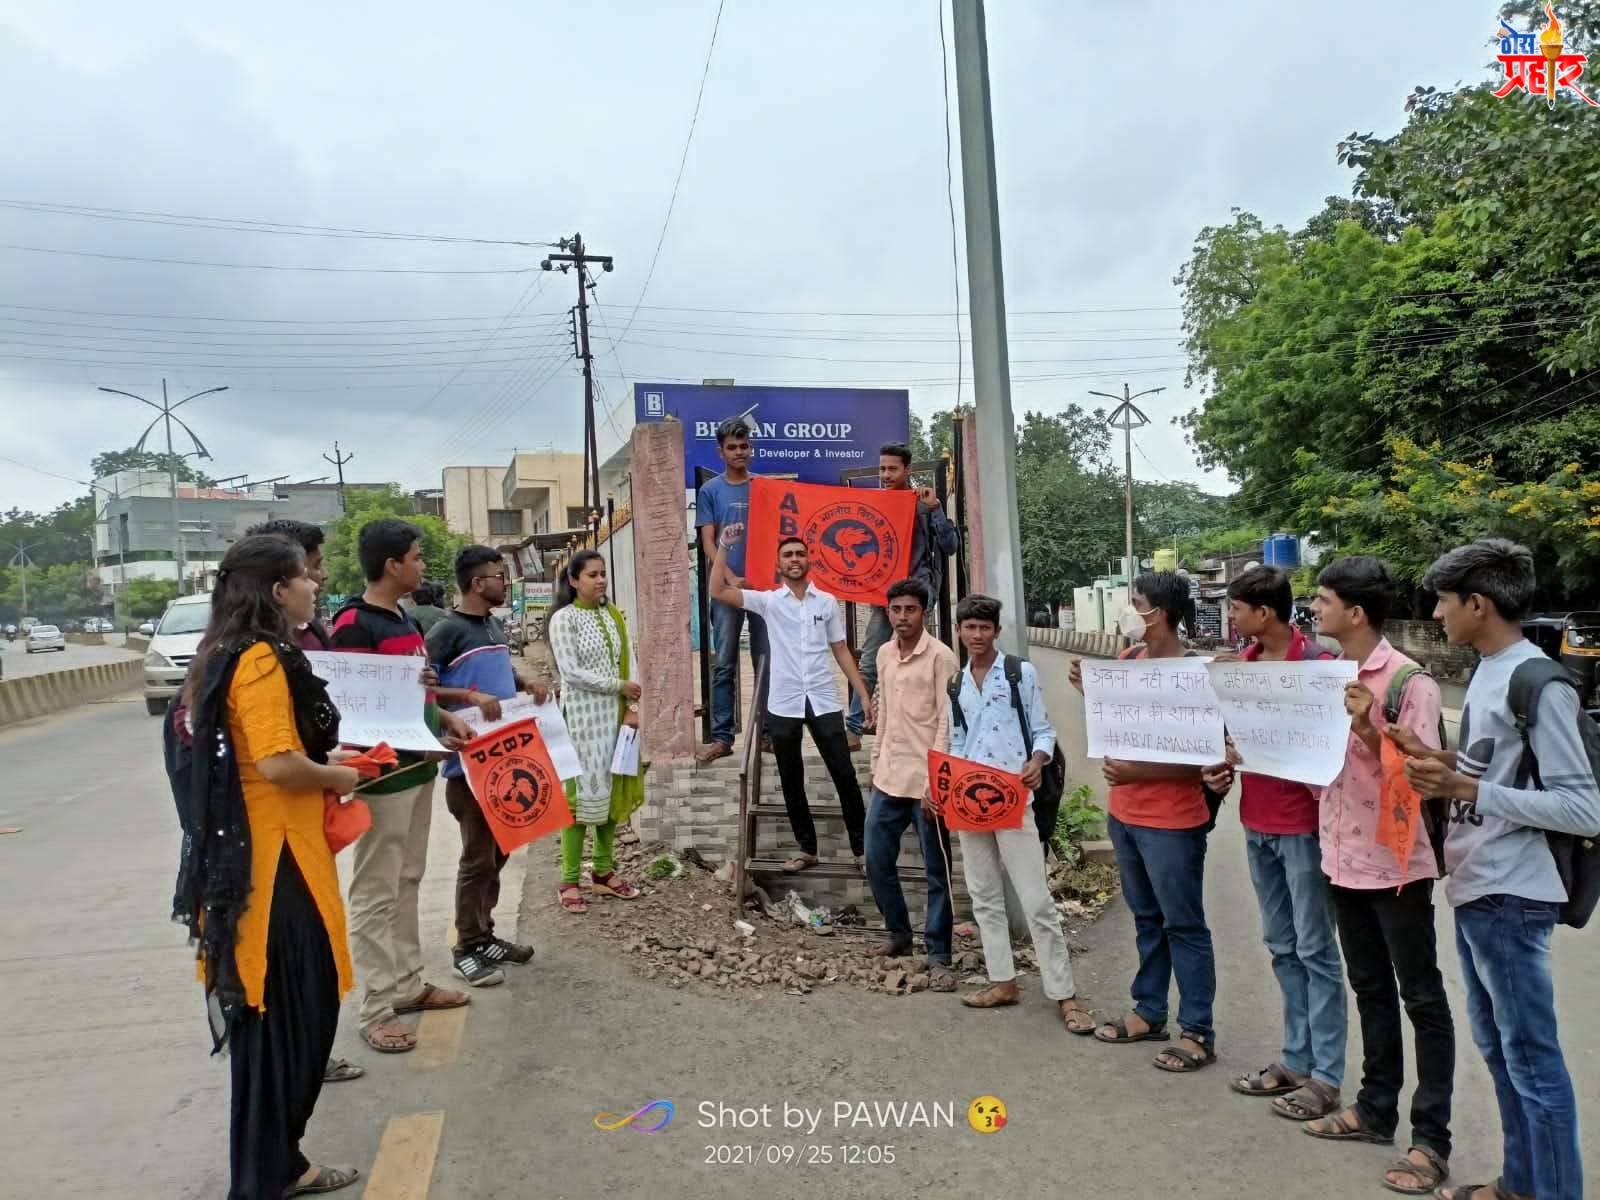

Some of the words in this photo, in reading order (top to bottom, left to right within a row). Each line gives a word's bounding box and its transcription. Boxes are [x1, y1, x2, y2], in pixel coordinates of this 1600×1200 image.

[784, 422, 852, 439] GROUP
[759, 448, 810, 459] Developer
[814, 449, 821, 459] &
[825, 448, 865, 459] Investor
[470, 732, 534, 764] ABVP
[937, 761, 952, 806] ABV
